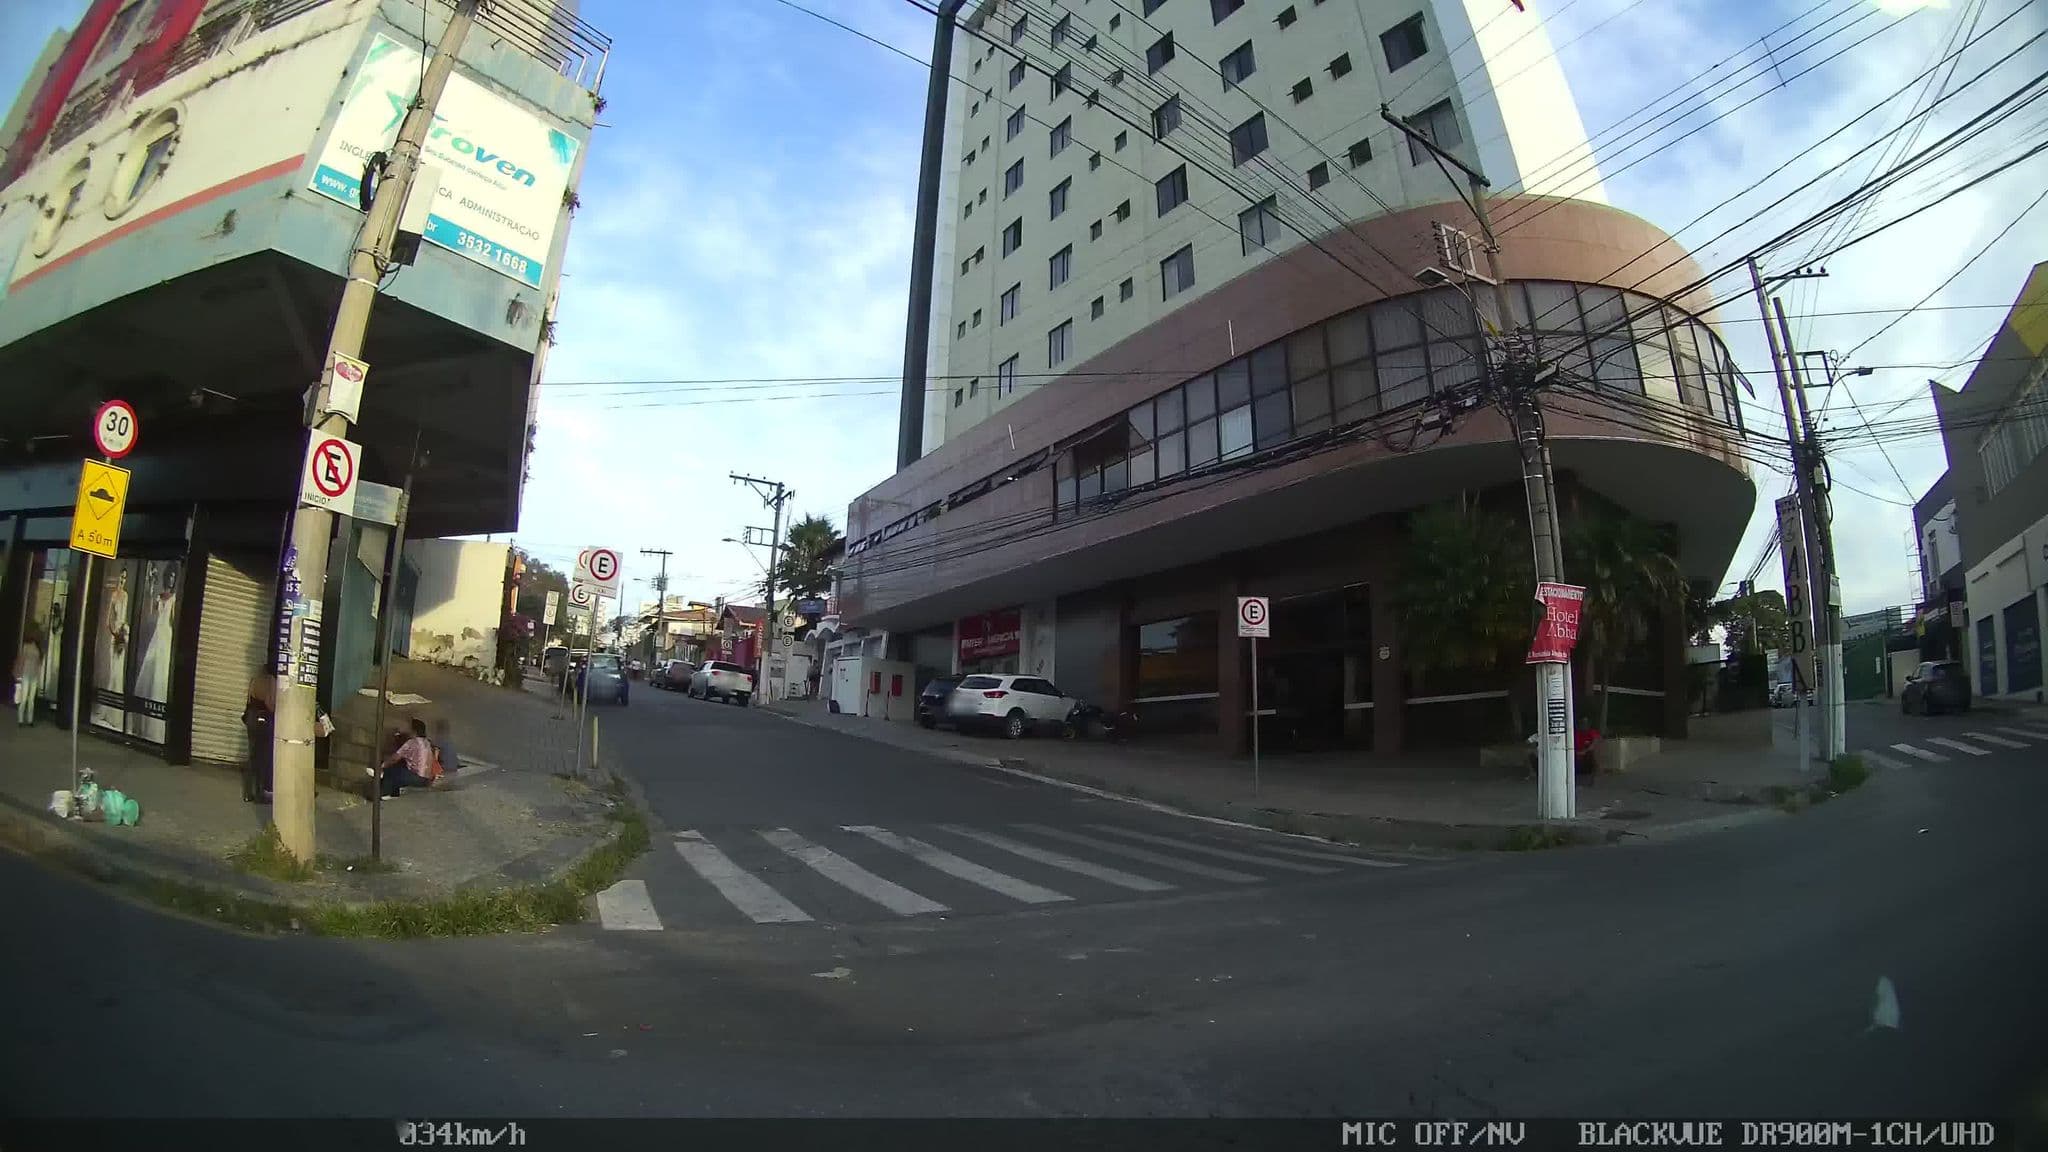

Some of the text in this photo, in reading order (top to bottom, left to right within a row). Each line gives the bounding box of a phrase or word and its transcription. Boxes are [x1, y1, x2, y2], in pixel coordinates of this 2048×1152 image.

[457, 231, 491, 257] 3532
[495, 248, 528, 273] 1668
[106, 411, 129, 436] 30
[325, 451, 341, 483] E
[77, 530, 113, 548] A 50m
[598, 557, 609, 574] E
[577, 589, 585, 600] E
[1250, 605, 1259, 619] E
[1546, 606, 1578, 625] Hotel
[1546, 623, 1578, 641] Abba
